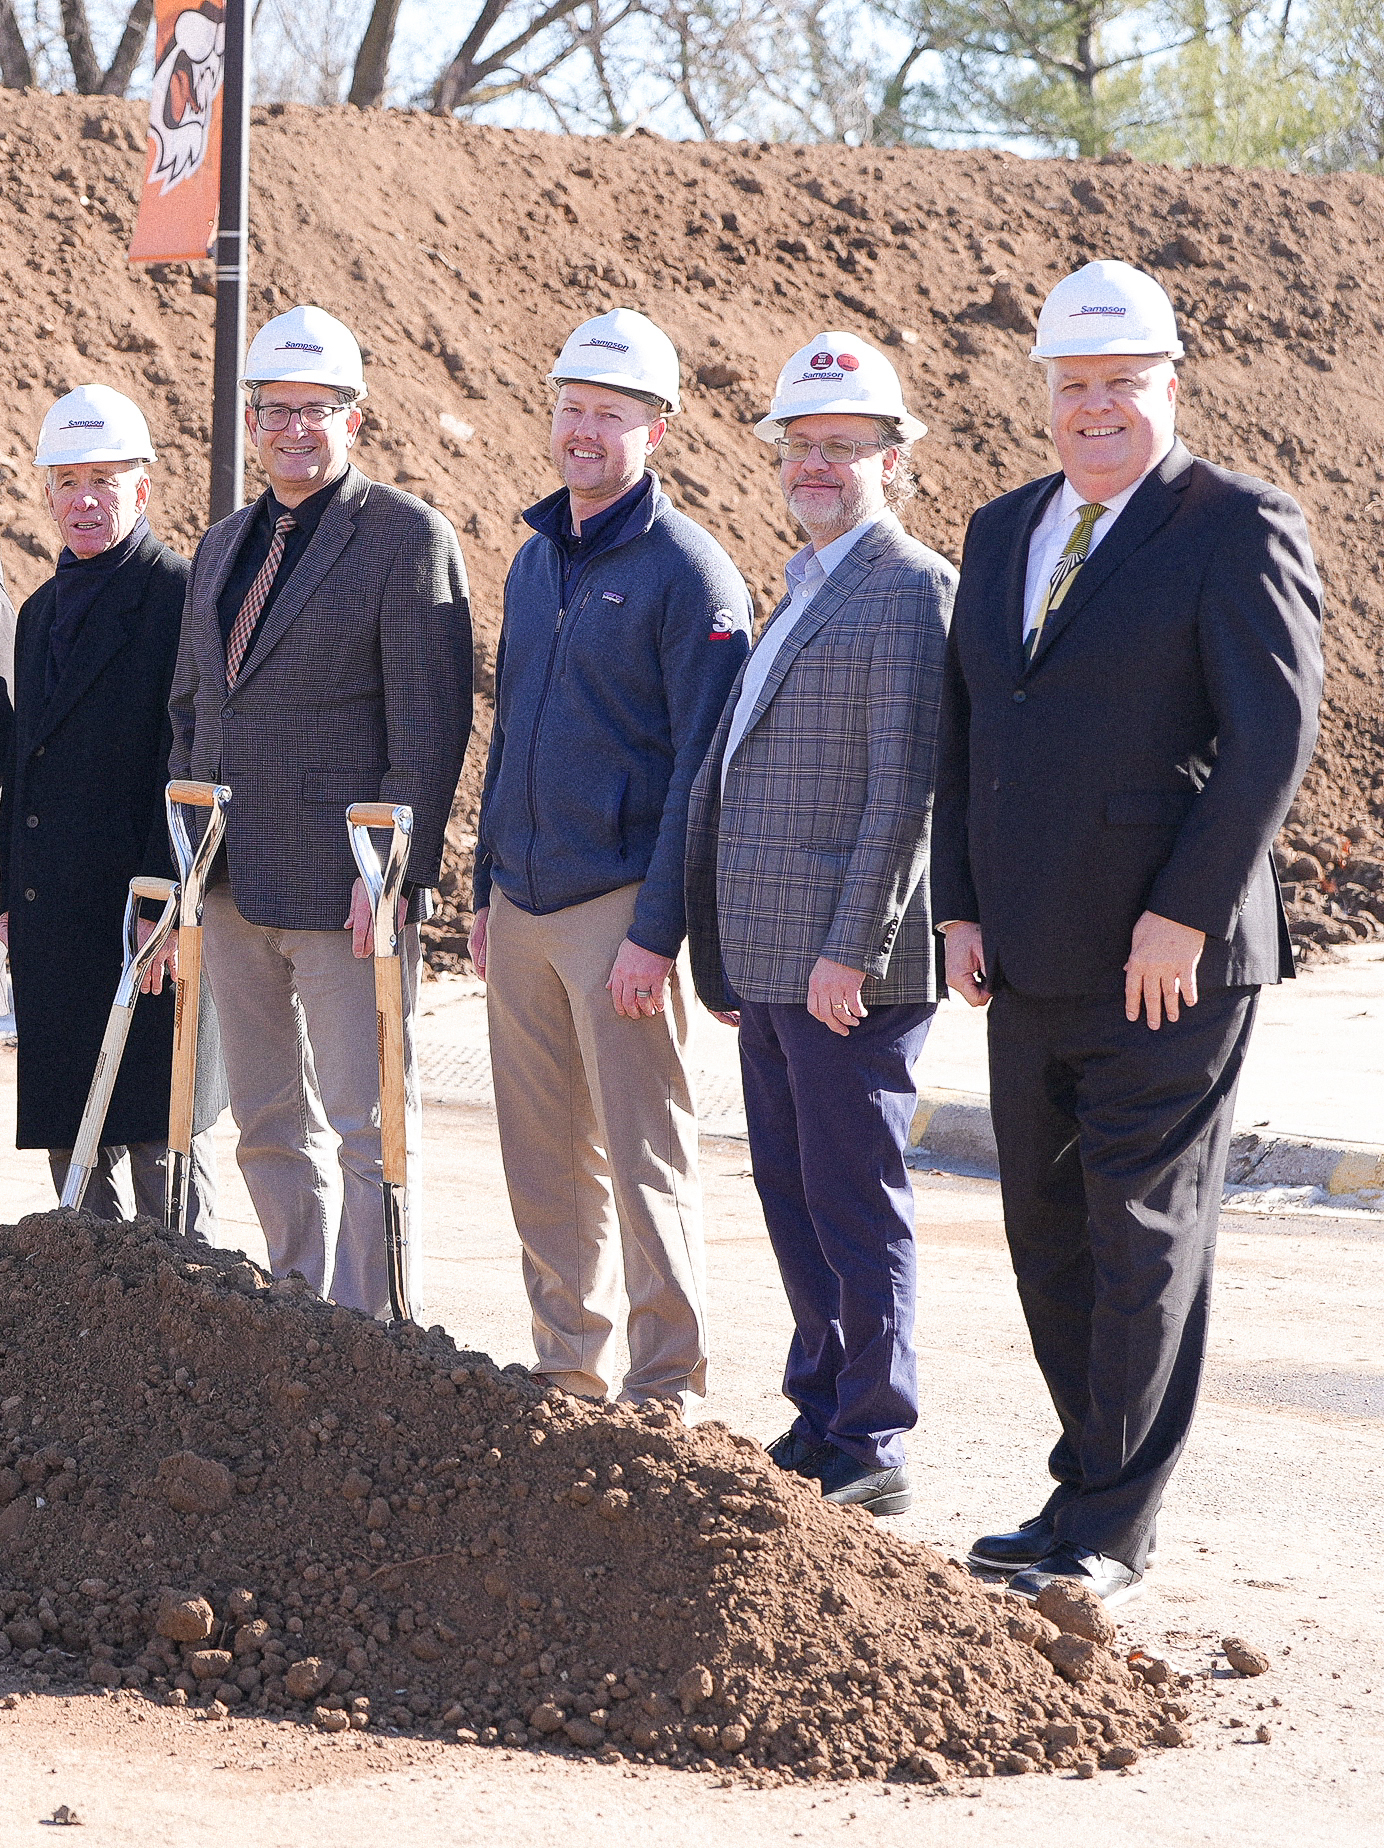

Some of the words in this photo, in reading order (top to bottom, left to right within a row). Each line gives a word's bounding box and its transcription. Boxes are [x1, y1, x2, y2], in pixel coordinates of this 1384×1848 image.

[1080, 306, 1126, 314] Sampson
[285, 341, 323, 352] Sampson
[590, 338, 629, 351] Sampson
[802, 372, 843, 380] Sampson
